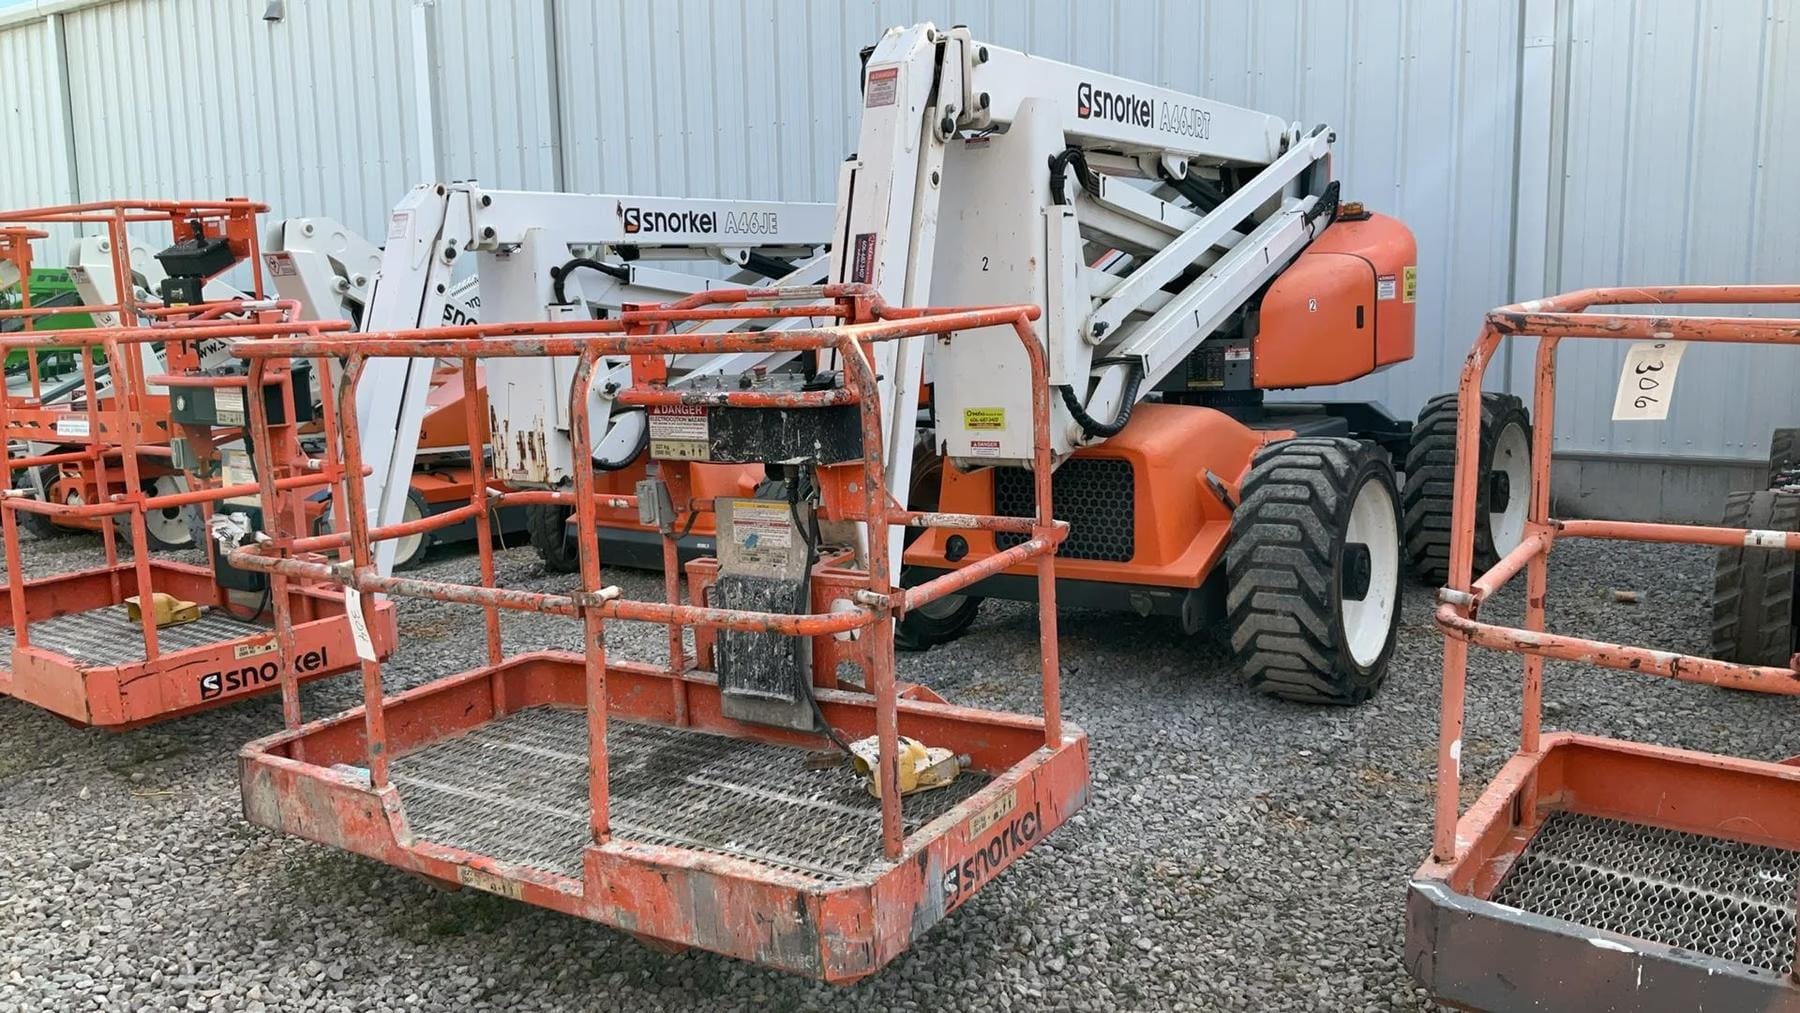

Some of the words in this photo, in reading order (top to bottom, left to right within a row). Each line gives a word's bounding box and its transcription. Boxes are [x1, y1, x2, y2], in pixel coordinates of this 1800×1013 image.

[1093, 90, 1154, 129] snorkel
[1159, 101, 1210, 140] A46JRT
[643, 210, 717, 234] snorkel
[724, 211, 778, 234] A46JE
[982, 256, 989, 271] 2
[1634, 360, 1665, 409] 306
[661, 405, 702, 414] DANGER
[225, 646, 328, 692] snokel
[962, 802, 1041, 891] snorkel
